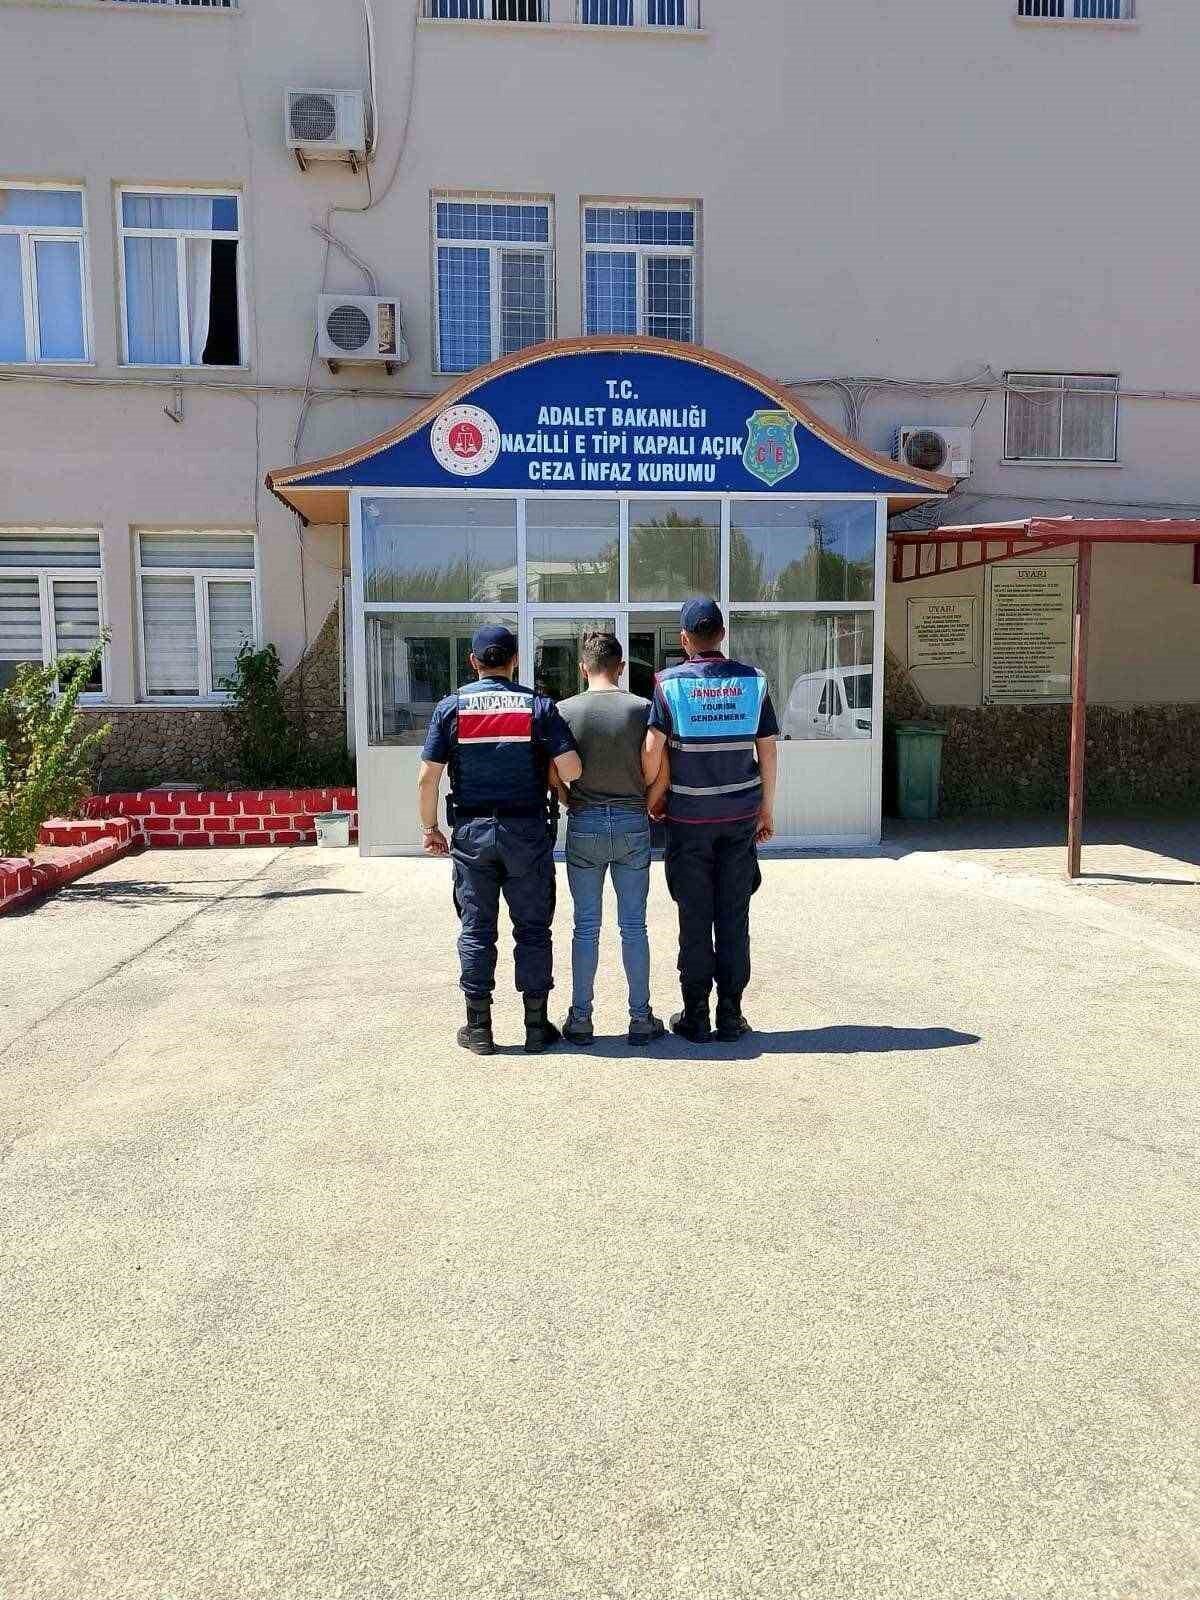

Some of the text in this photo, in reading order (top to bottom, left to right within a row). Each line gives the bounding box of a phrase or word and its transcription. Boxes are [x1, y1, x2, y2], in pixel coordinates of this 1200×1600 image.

[605, 379, 639, 400] T.C.
[537, 404, 707, 428] ADALET BAKANLIĞI
[501, 429, 743, 460] NAZİLLİ E TİPİ KAPALI AÇIK
[528, 457, 717, 483] CEZA İNFAZ KURUMU
[464, 695, 526, 710] JANDARMA
[691, 687, 743, 698] JANDARMA
